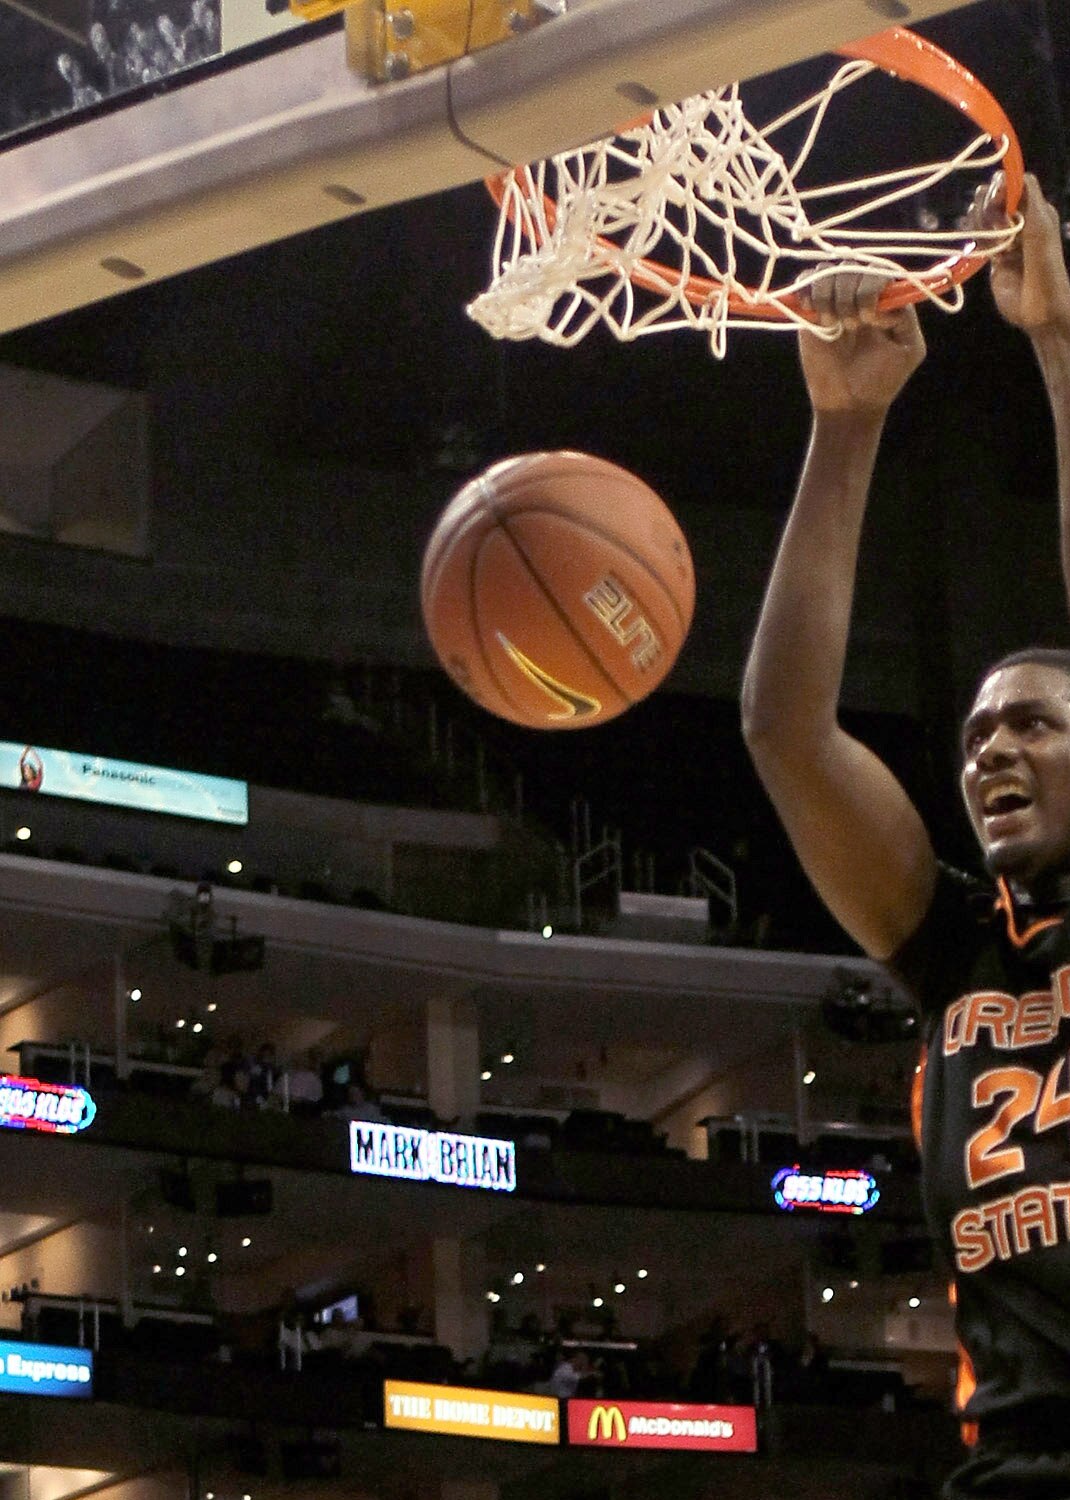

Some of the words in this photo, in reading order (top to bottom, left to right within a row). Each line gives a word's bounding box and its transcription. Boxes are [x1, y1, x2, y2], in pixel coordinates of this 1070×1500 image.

[82, 764, 156, 785] Panasonic
[355, 1127, 423, 1170] MARK
[440, 1139, 510, 1185] BRIAN
[7, 1354, 90, 1382] Express
[389, 1394, 432, 1420] THE
[433, 1399, 490, 1426] HOME
[492, 1404, 555, 1433] DEPOT
[629, 1416, 734, 1439] McDonald's
